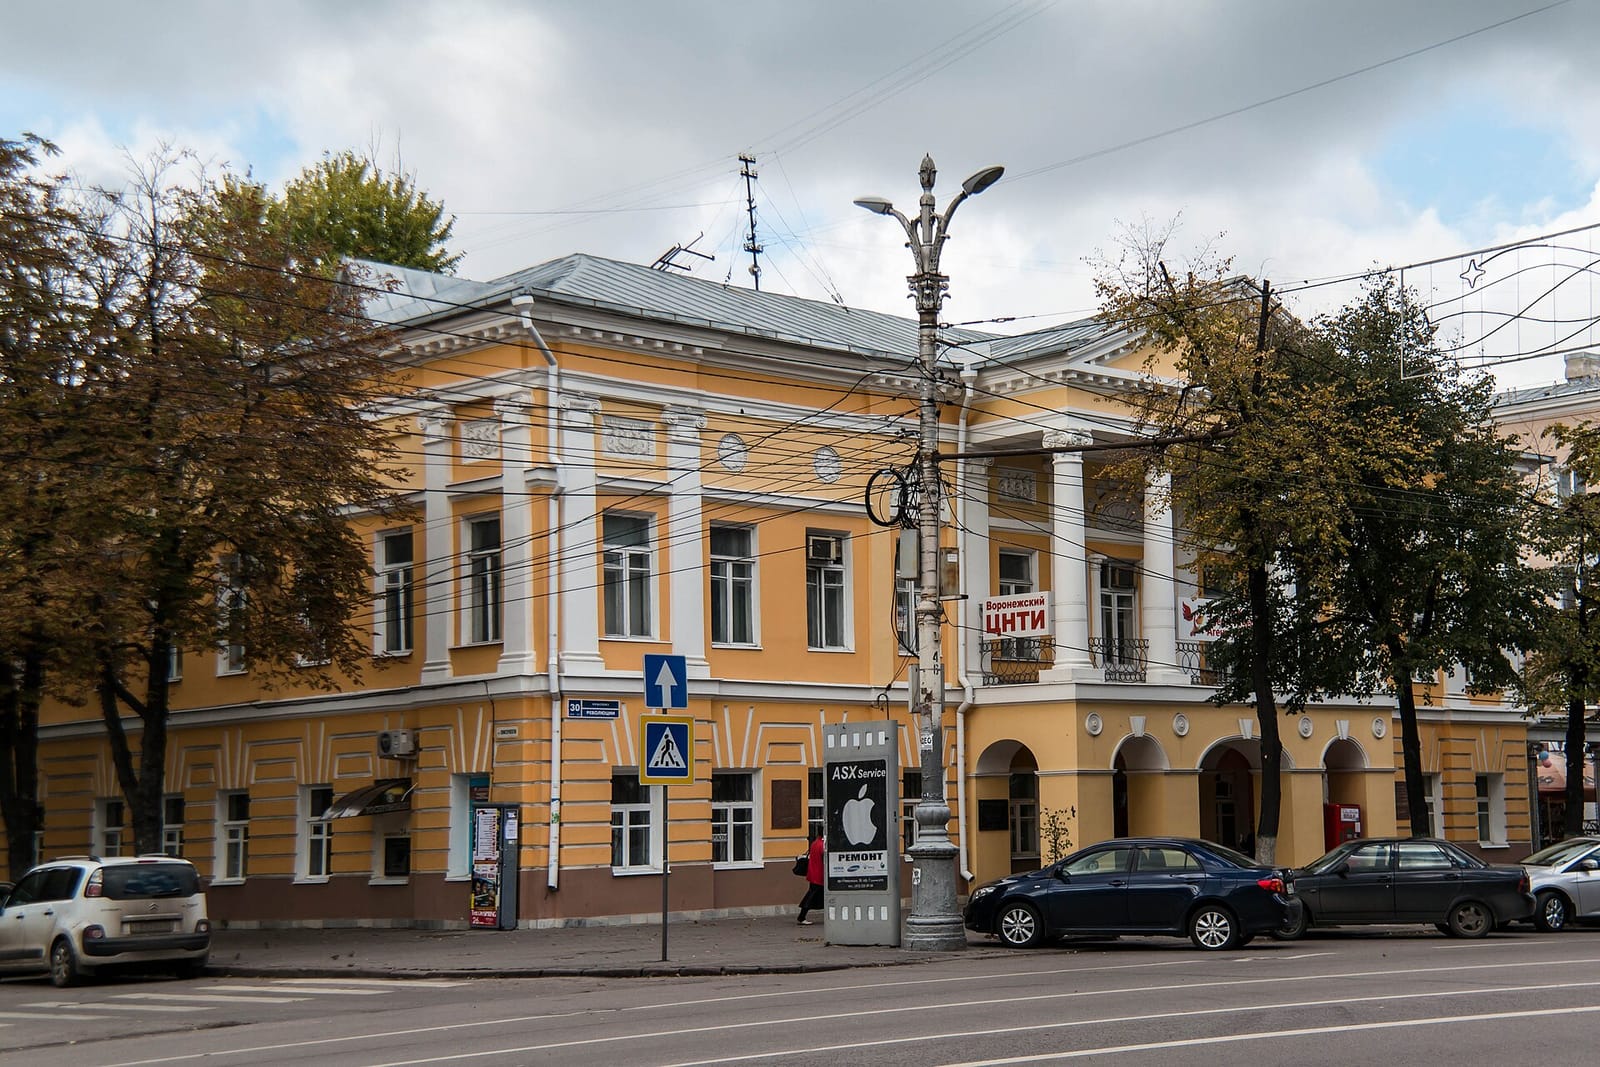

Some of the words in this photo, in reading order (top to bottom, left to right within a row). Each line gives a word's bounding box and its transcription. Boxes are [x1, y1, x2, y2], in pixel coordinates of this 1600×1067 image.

[986, 596, 1045, 612] Воронежский
[986, 610, 1045, 636] ЦНТИ
[570, 703, 581, 712] 30
[832, 765, 857, 780] ASX
[858, 768, 886, 779] Service
[838, 852, 883, 862] РЕМОНТ
